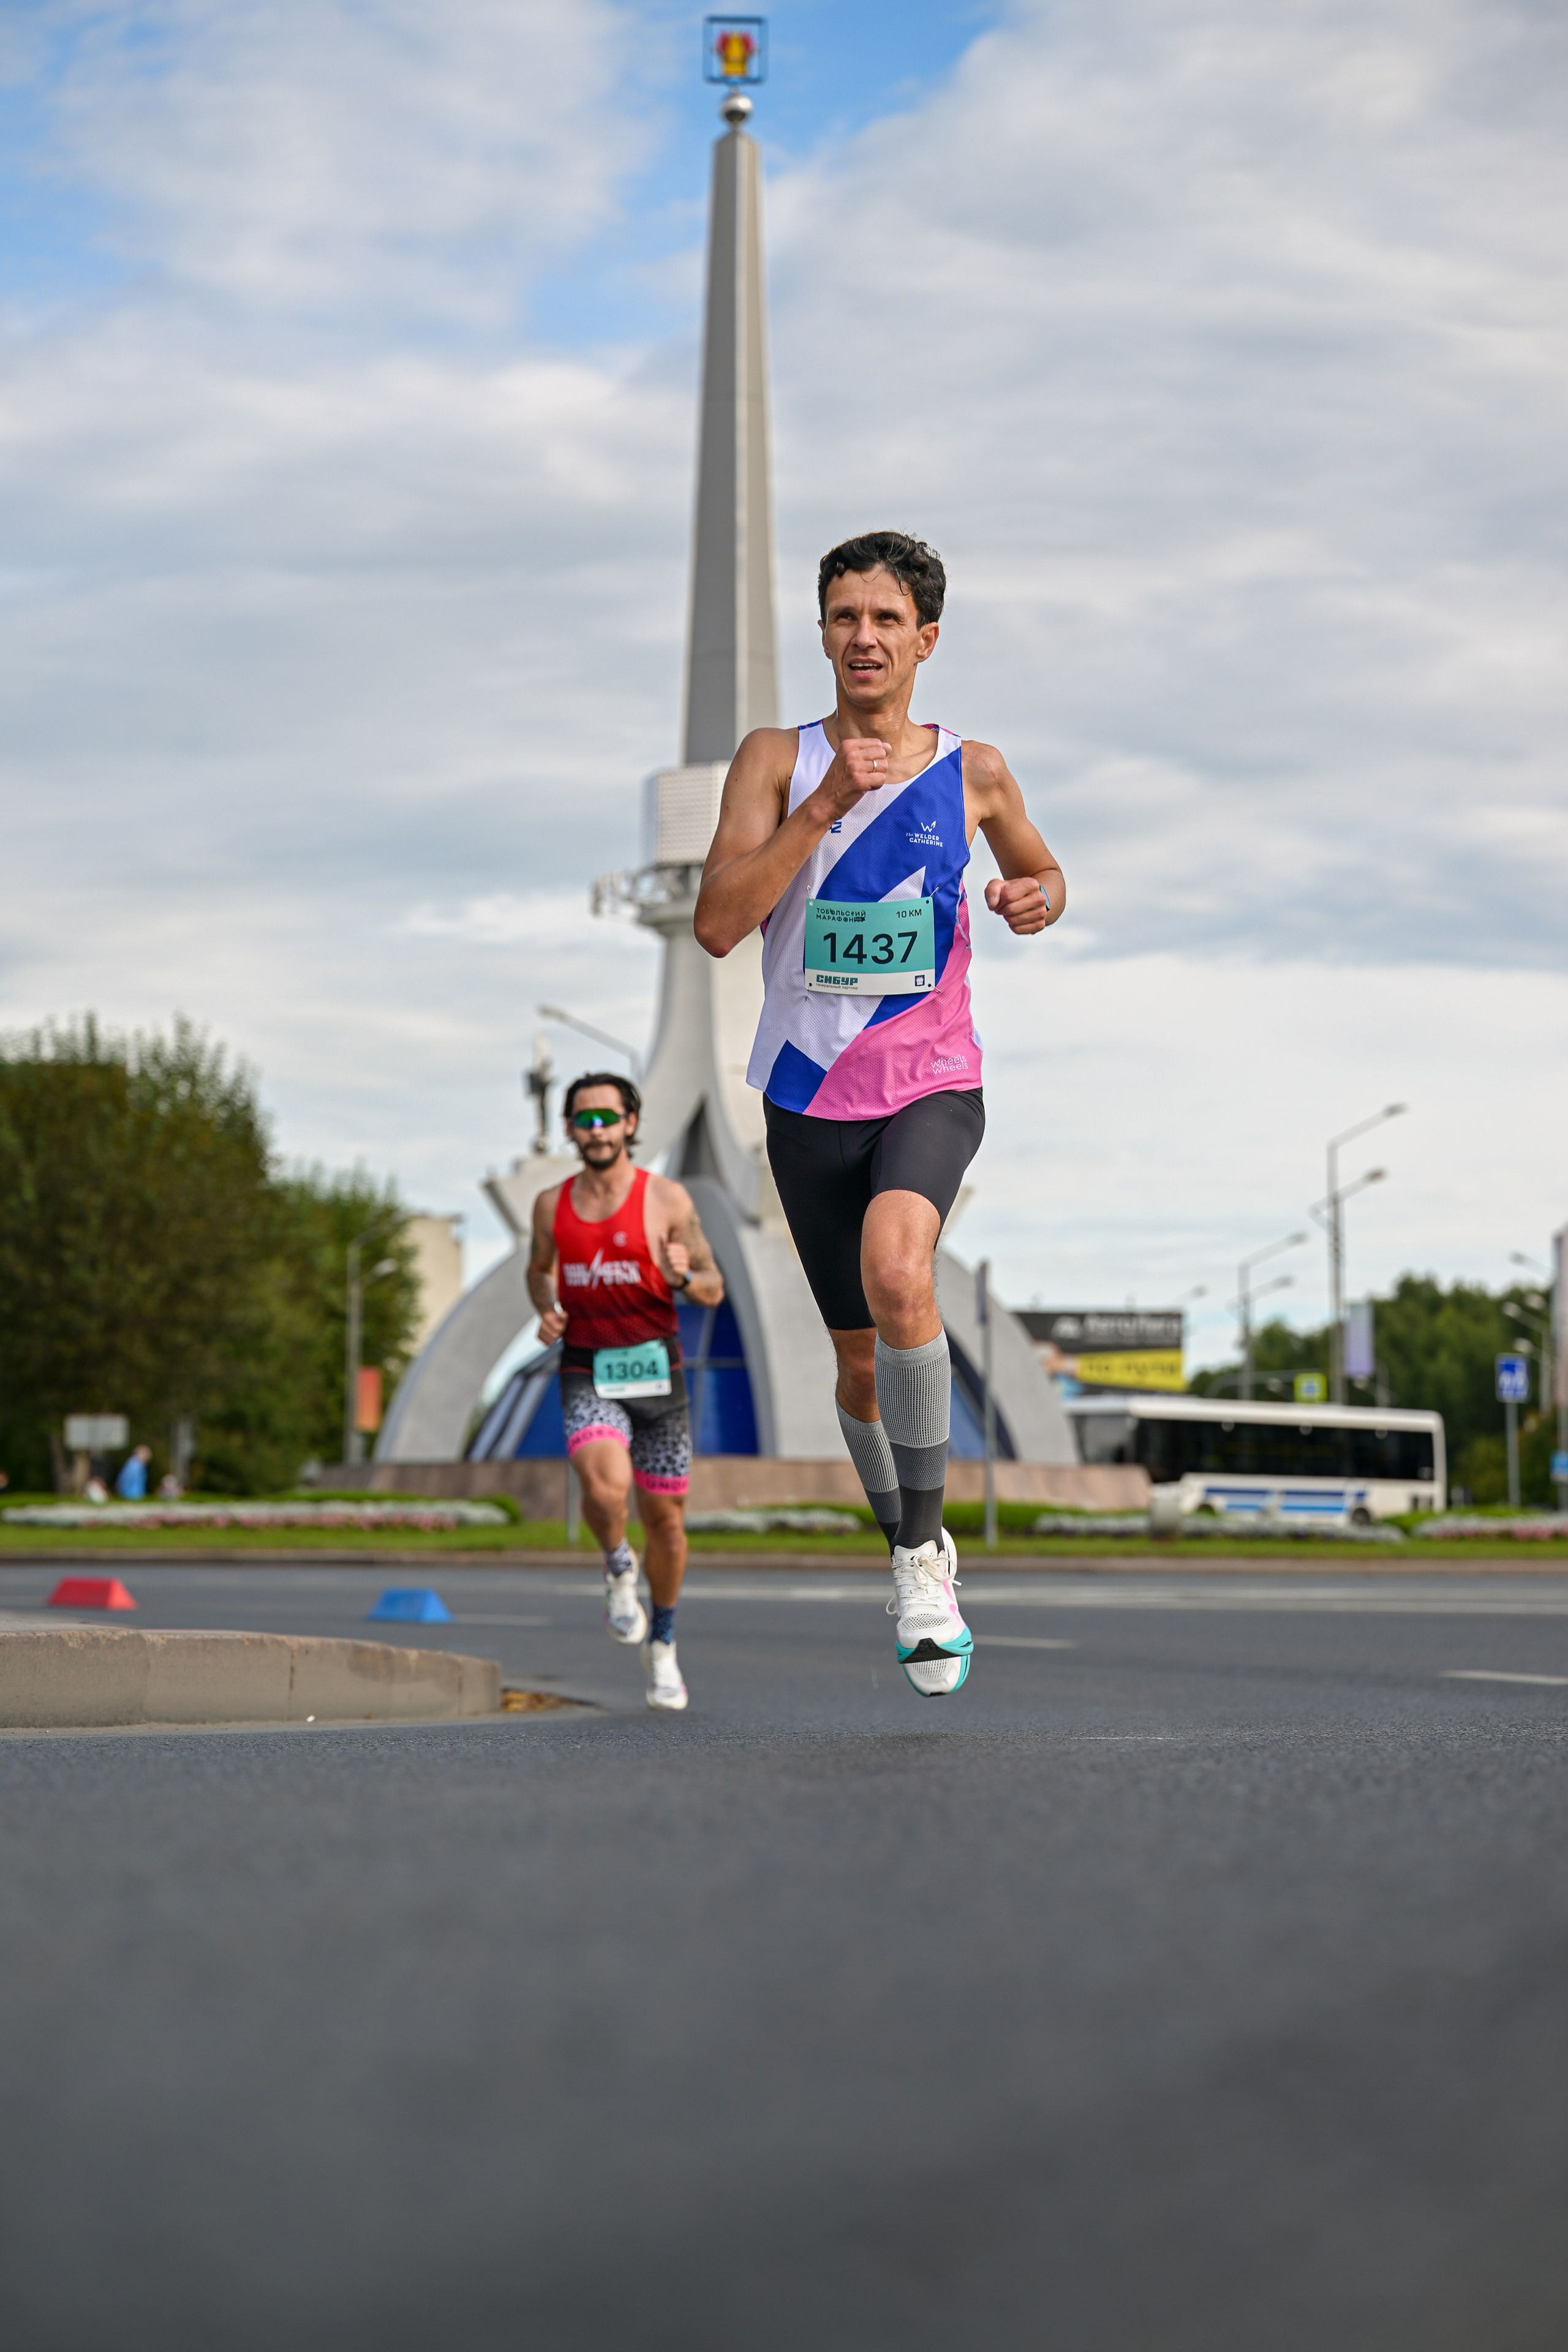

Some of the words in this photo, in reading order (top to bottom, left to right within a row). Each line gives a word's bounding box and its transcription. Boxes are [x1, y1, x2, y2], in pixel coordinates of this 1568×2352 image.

[910, 837, 943, 847] CATHERINE
[816, 914, 854, 922] МАРАФОН
[823, 931, 918, 965] 1437
[816, 974, 858, 986] СИБУР
[930, 1054, 967, 1068] wheels
[933, 1061, 968, 1075] wheels
[605, 1360, 658, 1379] 1304
